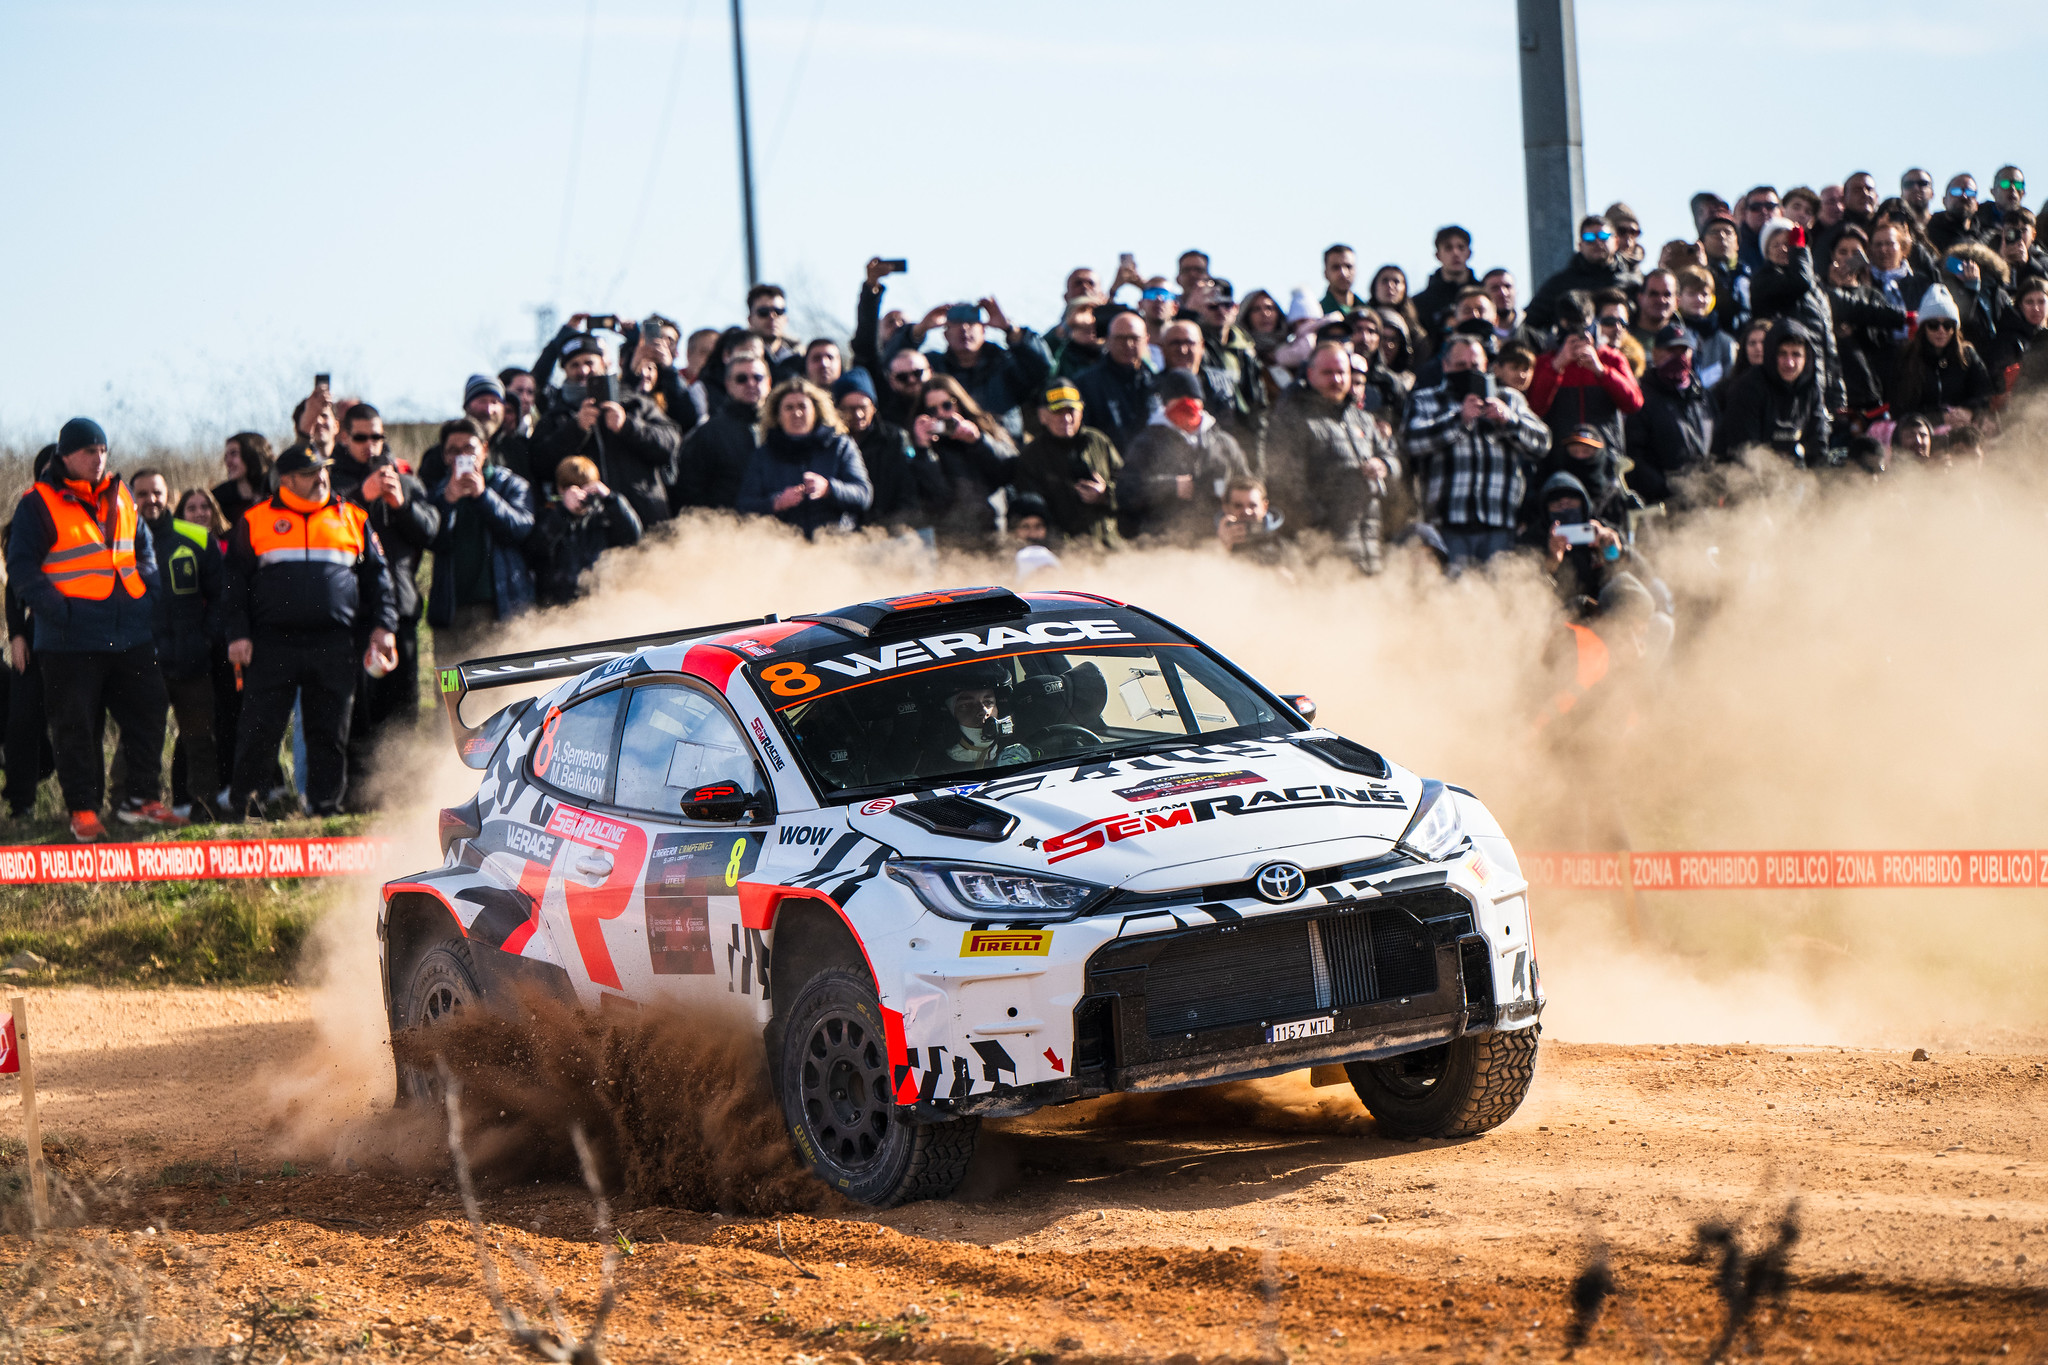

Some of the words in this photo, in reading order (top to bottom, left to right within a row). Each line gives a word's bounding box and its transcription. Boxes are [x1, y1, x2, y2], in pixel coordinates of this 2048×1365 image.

[760, 662, 821, 696] 8
[814, 619, 1136, 677] WERACE
[1044, 681, 1064, 693] OMP
[534, 706, 562, 777] 8
[551, 740, 608, 771] A.Semenov
[830, 751, 848, 761] OMP
[549, 762, 605, 794] M.Beliukov
[1134, 802, 1187, 815] TEAM
[506, 824, 555, 860] WERACE
[779, 826, 833, 846] WOW
[40, 850, 94, 878] PUBLICO
[99, 849, 134, 877] ZONA
[137, 846, 205, 876] PROHIBIDO
[209, 845, 264, 875] PUBLICO
[268, 844, 304, 873] ZONA
[725, 838, 747, 887] 8
[1633, 858, 1674, 885] ZONA
[1680, 856, 1758, 885] PROHIBIDO
[1766, 856, 1828, 884] PUBLICO
[1836, 856, 1877, 884] ZONA
[1883, 855, 1962, 883] PROHIBIDO
[1969, 855, 2032, 883] PUBLICO
[970, 934, 1043, 952] PIRELLI
[1275, 1023, 1305, 1040] 1157
[1310, 1020, 1333, 1035] MTL
